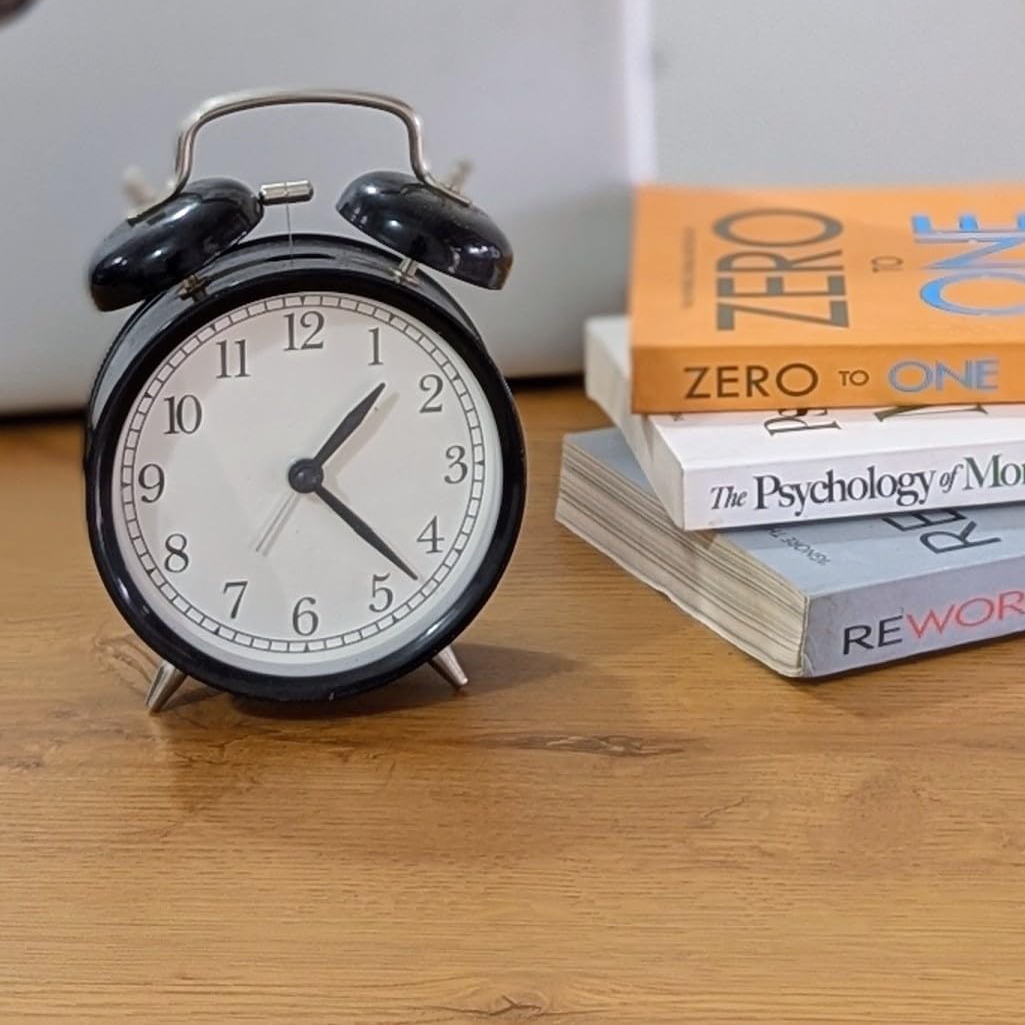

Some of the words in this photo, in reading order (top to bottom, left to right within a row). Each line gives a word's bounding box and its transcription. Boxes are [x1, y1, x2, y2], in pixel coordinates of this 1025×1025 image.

[711, 207, 850, 331] ZERO
[283, 310, 325, 350] 12
[368, 327, 384, 366] 1
[215, 339, 251, 379] 11
[683, 362, 819, 400] ZERO
[838, 370, 870, 387] TO
[887, 357, 1000, 393] ONE
[419, 374, 443, 414] 2
[164, 394, 202, 435] 10
[138, 463, 165, 503] 9
[444, 445, 468, 484] 3
[710, 484, 749, 511] The
[754, 466, 936, 517] Psychology
[938, 463, 964, 494] of
[165, 533, 189, 573] 8
[417, 516, 445, 554] 4
[222, 581, 249, 620] 7
[369, 573, 394, 613] 5
[292, 597, 319, 636] 6
